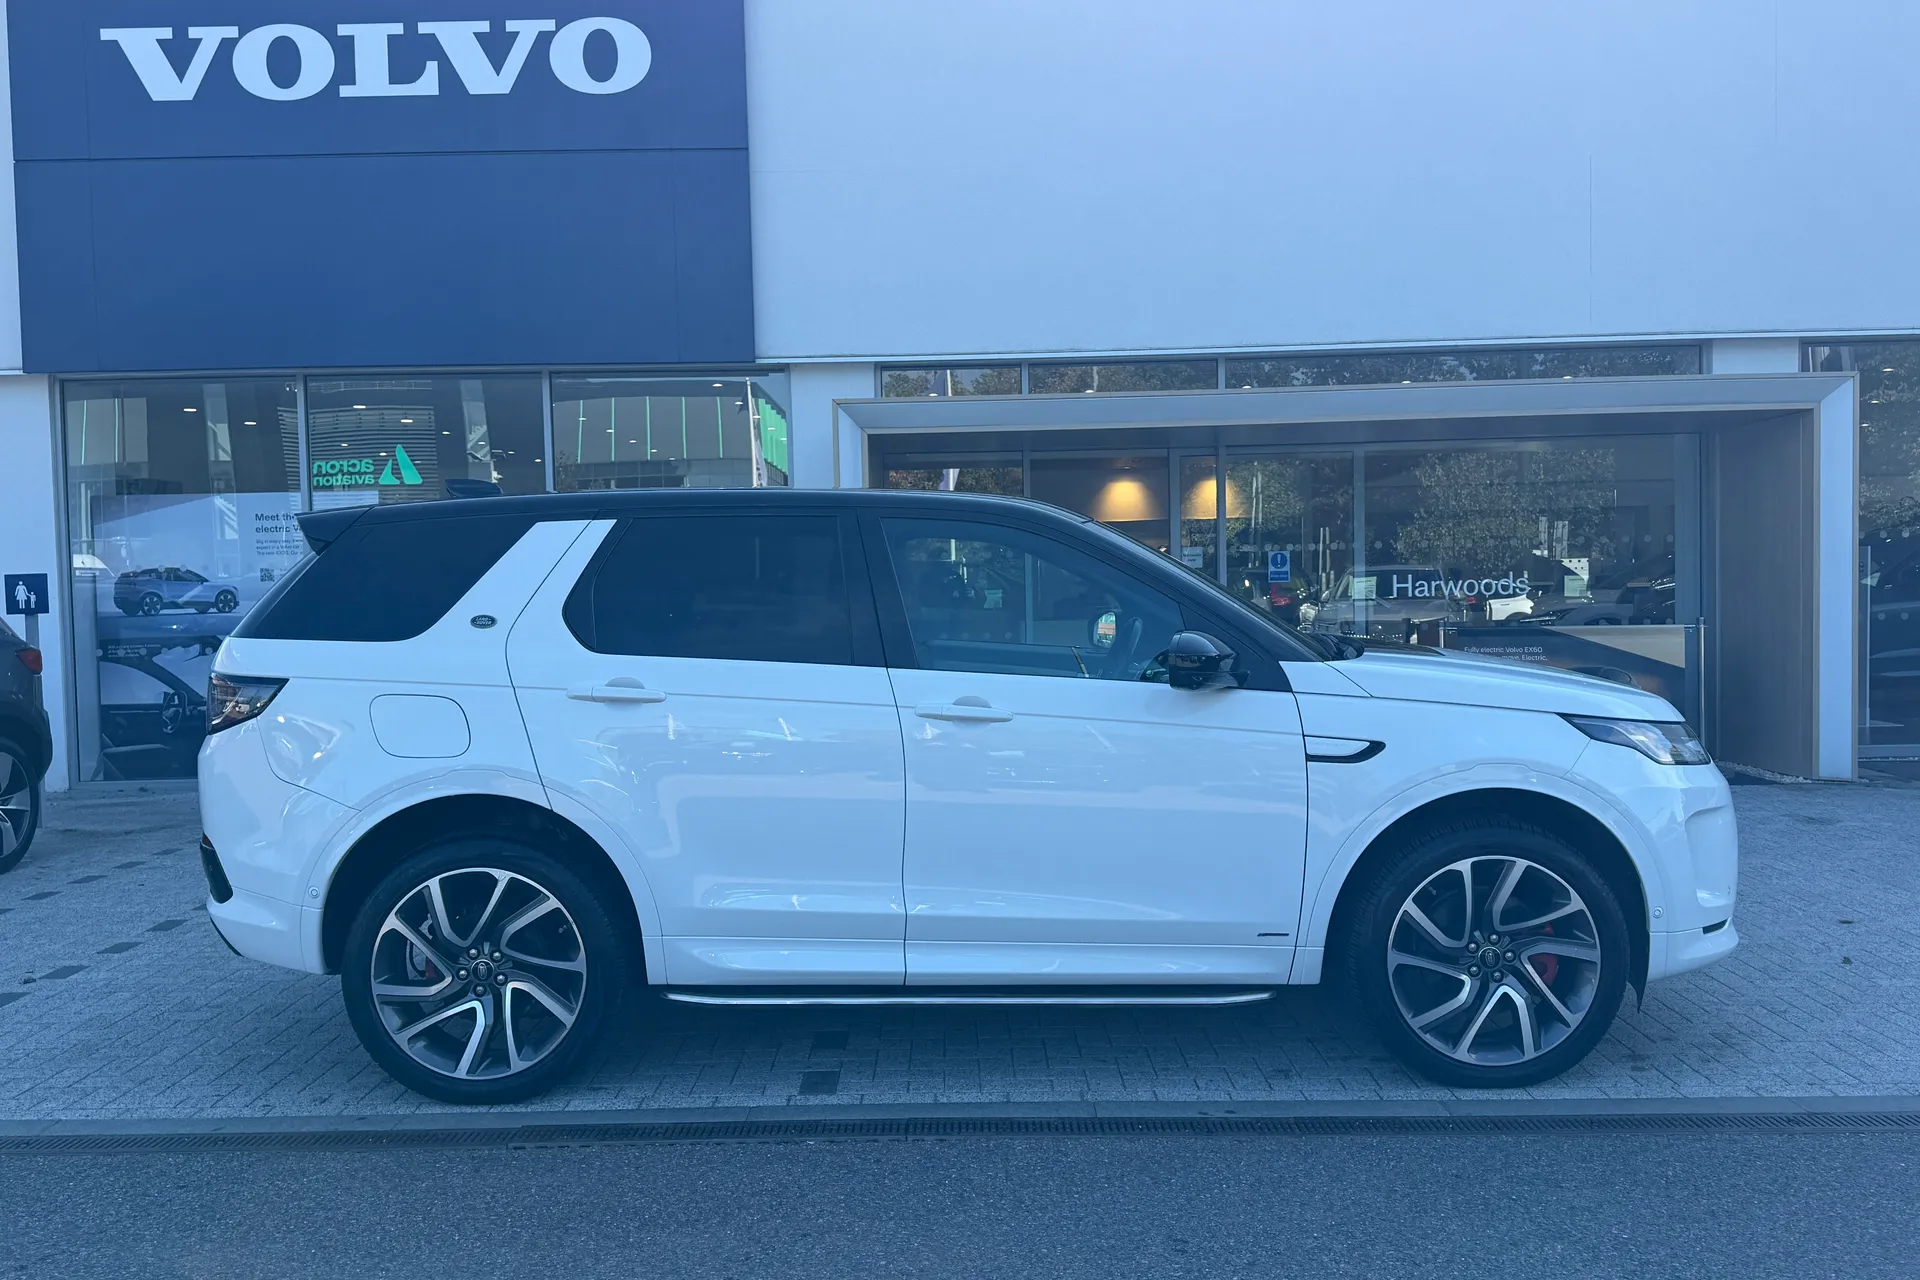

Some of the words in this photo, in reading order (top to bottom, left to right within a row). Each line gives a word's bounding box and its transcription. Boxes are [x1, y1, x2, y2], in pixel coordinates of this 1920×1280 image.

[100, 16, 652, 101] VOLVO
[255, 513, 280, 522] Meet
[255, 524, 291, 533] electric
[1392, 571, 1531, 598] Harwoods
